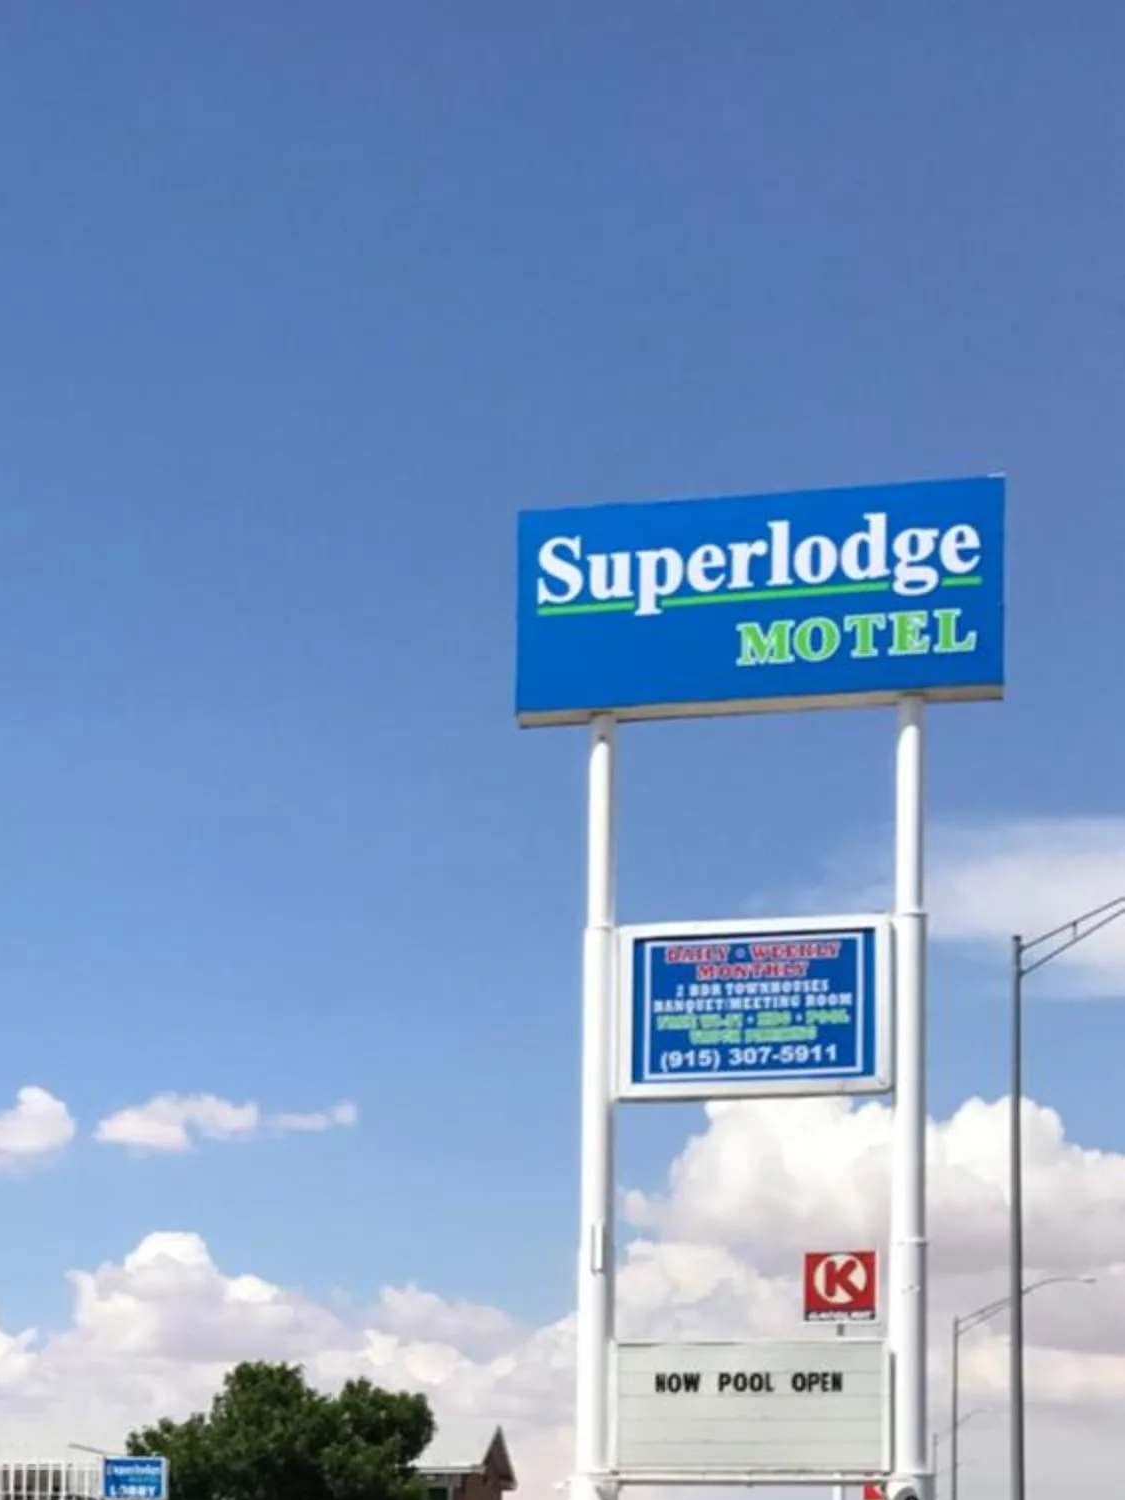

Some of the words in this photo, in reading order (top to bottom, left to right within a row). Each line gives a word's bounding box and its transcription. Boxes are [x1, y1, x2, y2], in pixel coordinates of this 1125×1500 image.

[537, 512, 981, 617] Superlodge
[736, 608, 977, 666] MOTEL
[660, 1048, 721, 1072] (915)
[728, 1044, 837, 1066] 307-5911
[655, 1373, 701, 1393] NOW
[719, 1373, 774, 1393] POOL
[791, 1372, 843, 1393] OPEN
